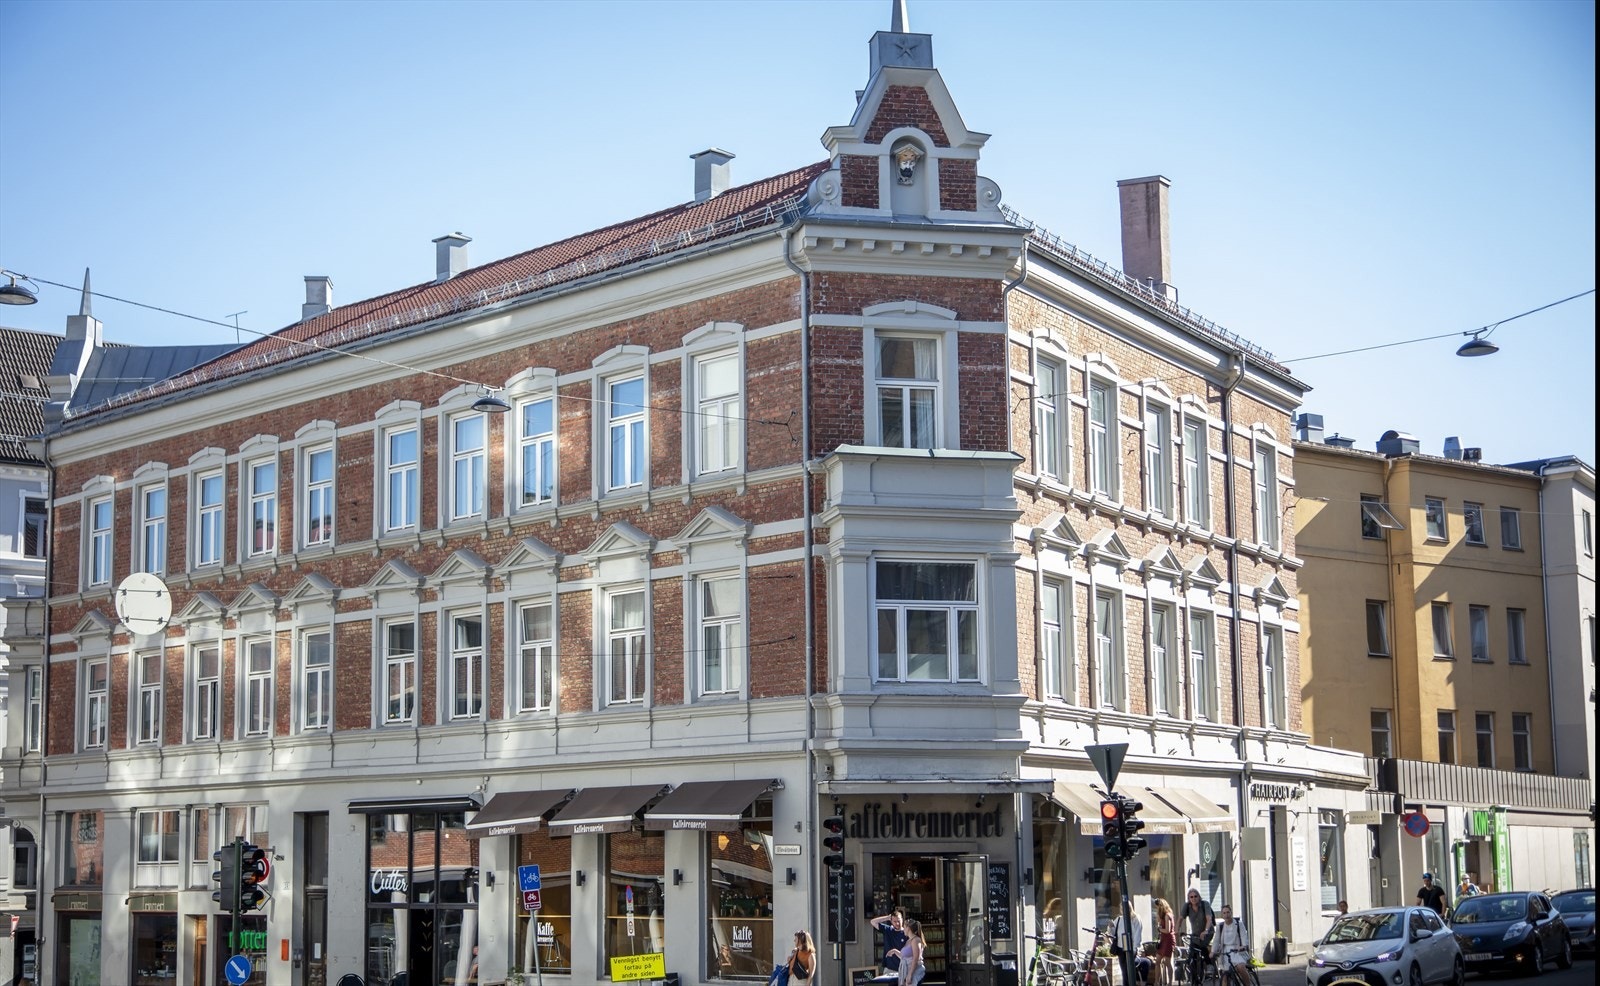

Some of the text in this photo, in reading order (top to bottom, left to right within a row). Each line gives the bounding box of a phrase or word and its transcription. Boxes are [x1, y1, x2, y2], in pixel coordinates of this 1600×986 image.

[1255, 784, 1290, 799] HAIRPORT
[574, 824, 604, 834] Kaffebrenneriet
[672, 819, 707, 829] Kaffebrenneriet
[488, 826, 516, 836] Kaffebrenneriet
[371, 868, 408, 894] Cutter
[537, 922, 554, 936] Kaffe
[732, 925, 752, 940] Kaffe
[613, 954, 661, 965] Vennligst benytt
